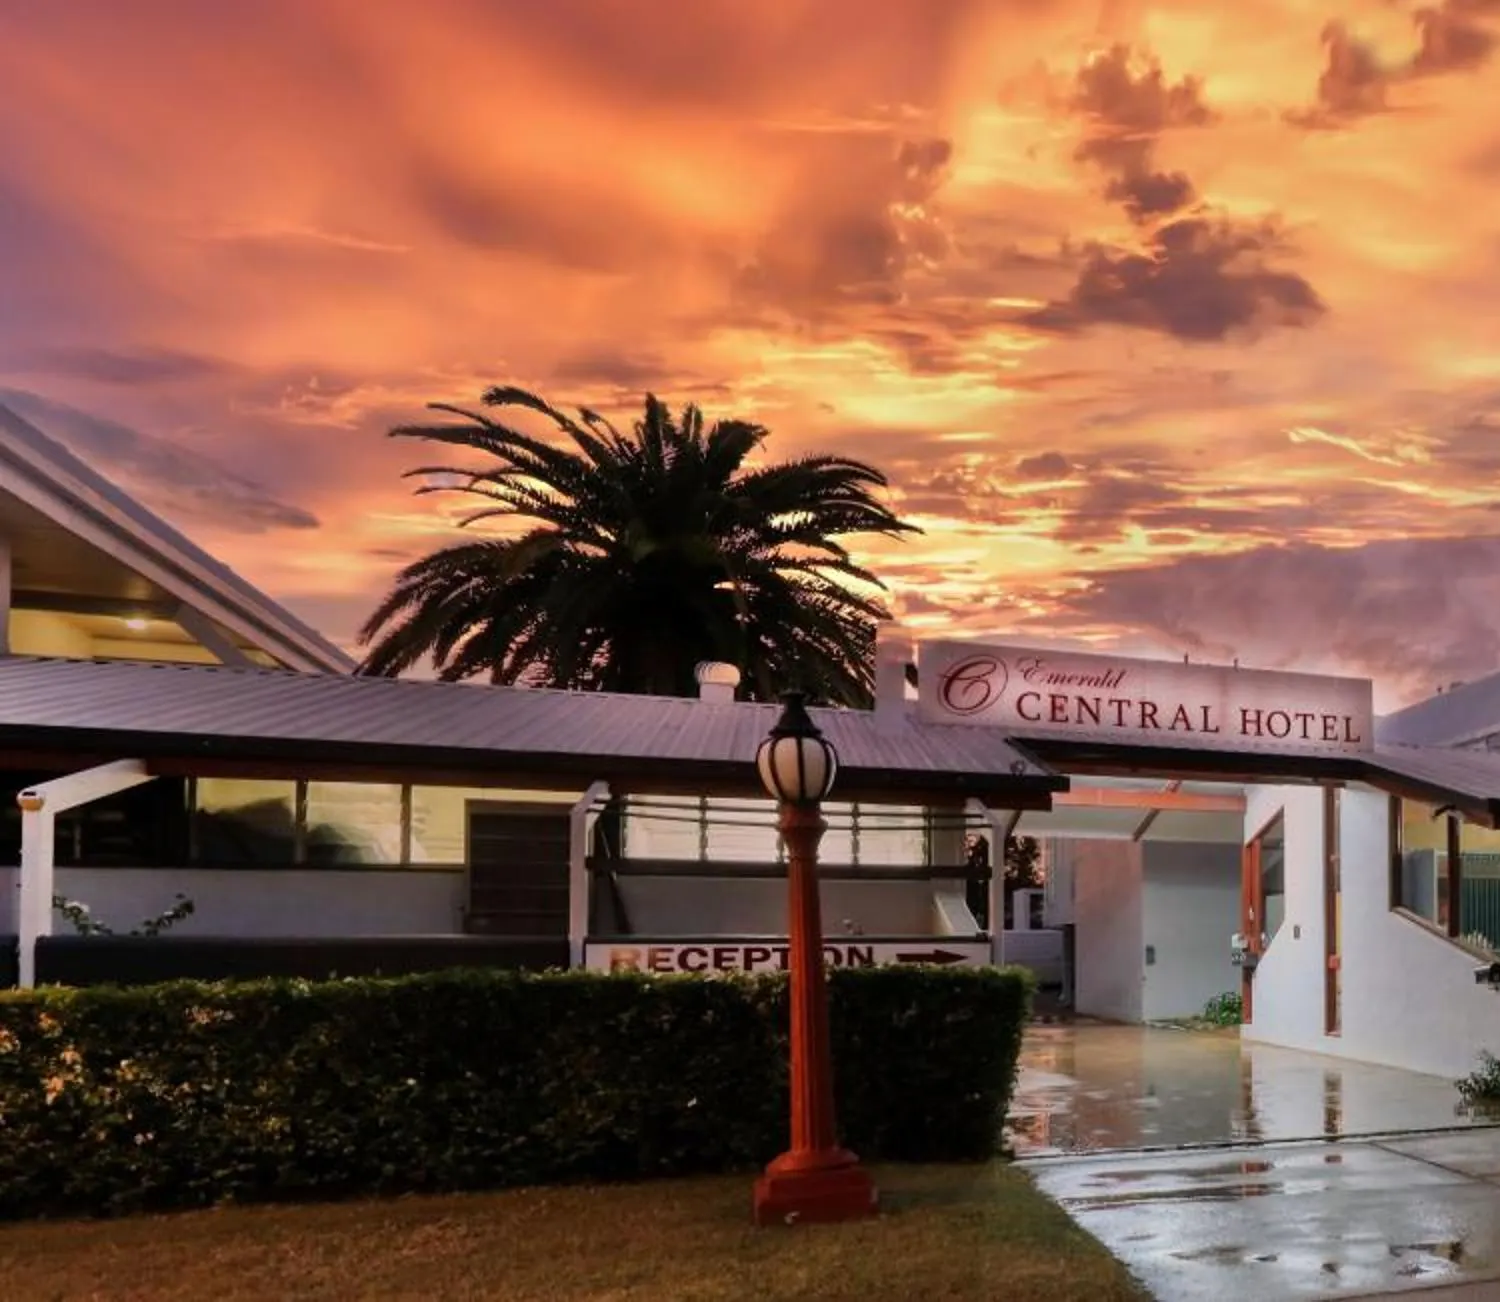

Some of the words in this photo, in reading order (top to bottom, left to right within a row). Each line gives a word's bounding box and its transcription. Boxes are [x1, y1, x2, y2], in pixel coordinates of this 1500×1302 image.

[1016, 656, 1126, 689] Emerald
[1016, 692, 1220, 734] CENTRAL
[1241, 708, 1361, 744] HOTEL
[610, 945, 874, 972] RECEPTON
